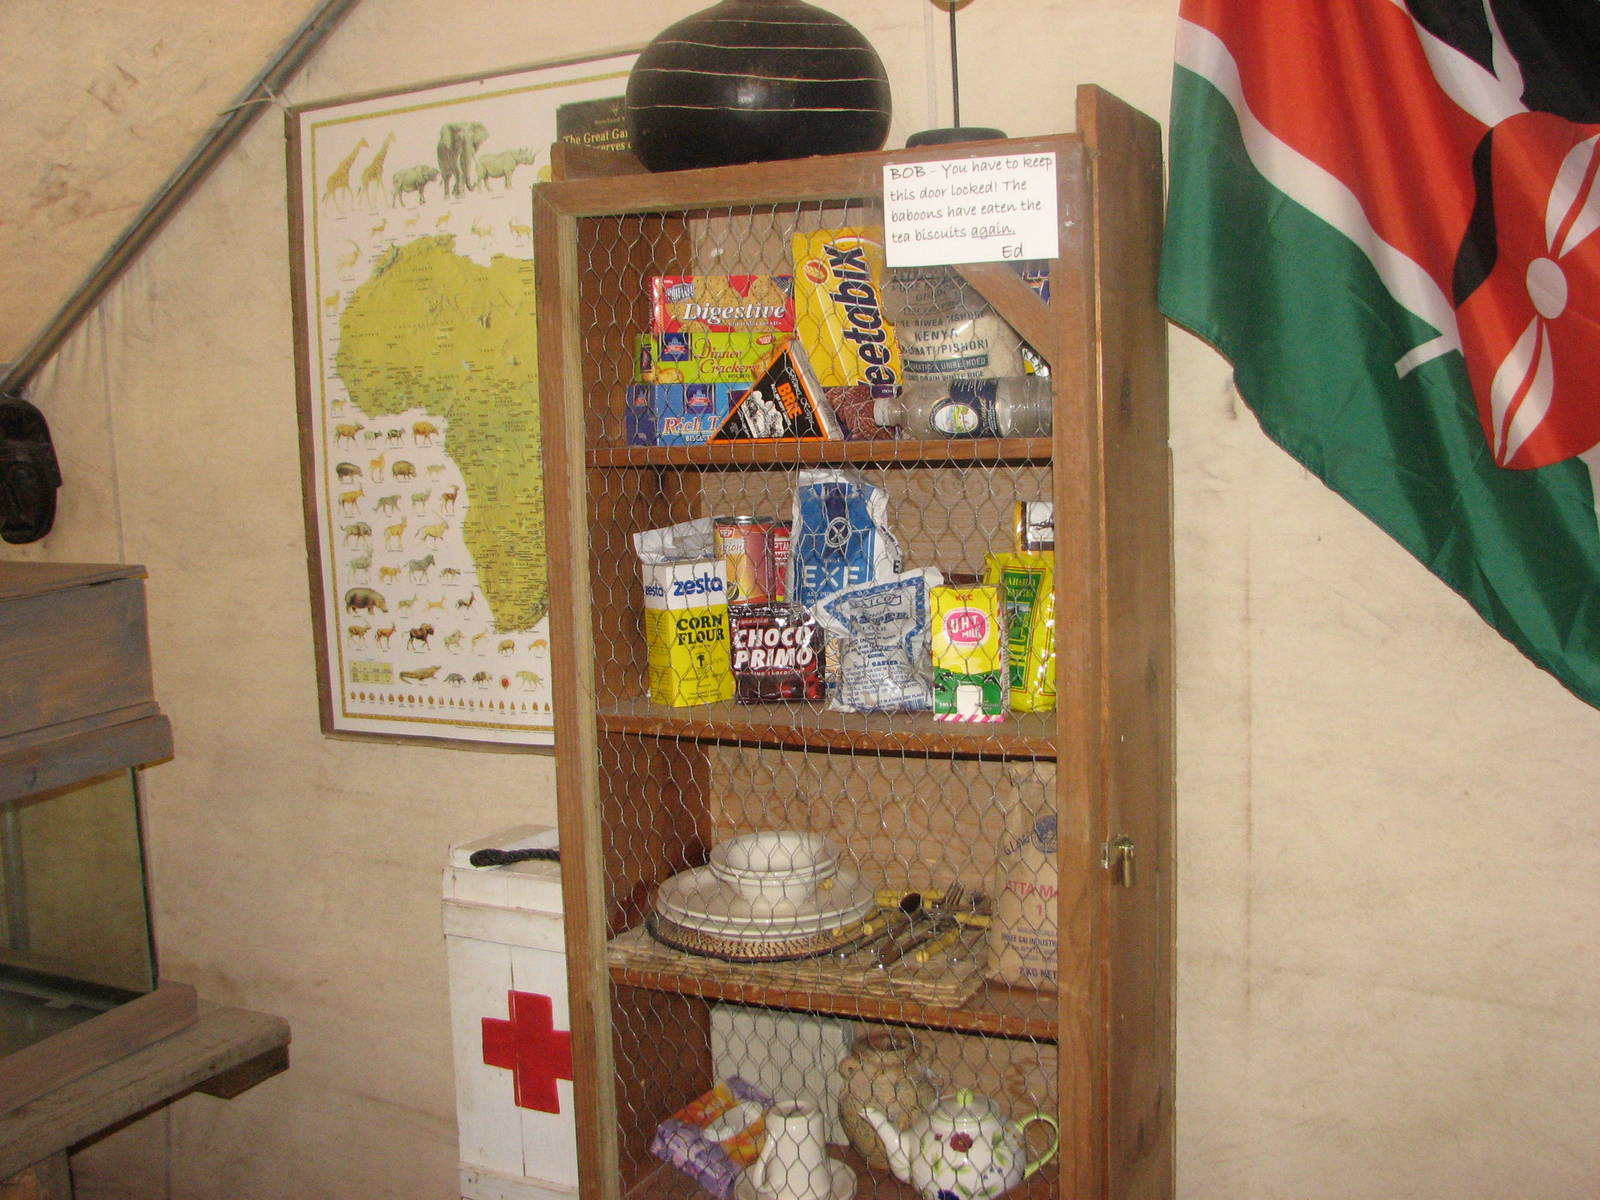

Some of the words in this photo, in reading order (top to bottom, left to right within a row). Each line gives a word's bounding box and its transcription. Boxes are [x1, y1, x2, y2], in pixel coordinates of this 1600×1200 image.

[563, 134, 581, 145] The
[584, 131, 609, 143] Great
[612, 128, 628, 140] Ga
[889, 166, 926, 180] BOB
[941, 164, 967, 180] You
[972, 159, 1002, 172] have
[1006, 159, 1018, 170] to
[1023, 156, 1052, 170] keep
[890, 190, 916, 202] this
[920, 187, 947, 198] door
[951, 182, 998, 197] locked!
[1004, 180, 1027, 191] The
[891, 209, 943, 223] baboons
[947, 204, 977, 217] have
[981, 202, 1017, 215] eaten
[1021, 199, 1042, 210] the
[891, 232, 911, 243] tea
[915, 226, 967, 241] biscuits
[971, 224, 1016, 239] again.
[1001, 243, 1024, 258] Ed
[684, 303, 786, 325] Digestive
[823, 245, 896, 385] eetabix
[914, 328, 959, 342] KENYA
[694, 338, 742, 360] Dinner
[700, 358, 758, 374] Crackers
[663, 416, 702, 435] Rich
[673, 572, 724, 597] zesta
[803, 565, 859, 588] EXE
[644, 584, 664, 597] zesta
[676, 613, 722, 632] CORN
[678, 628, 725, 646] FLOUR
[733, 626, 811, 648] CHOCO
[962, 628, 982, 639] MILK
[733, 646, 812, 670] PRIMO
